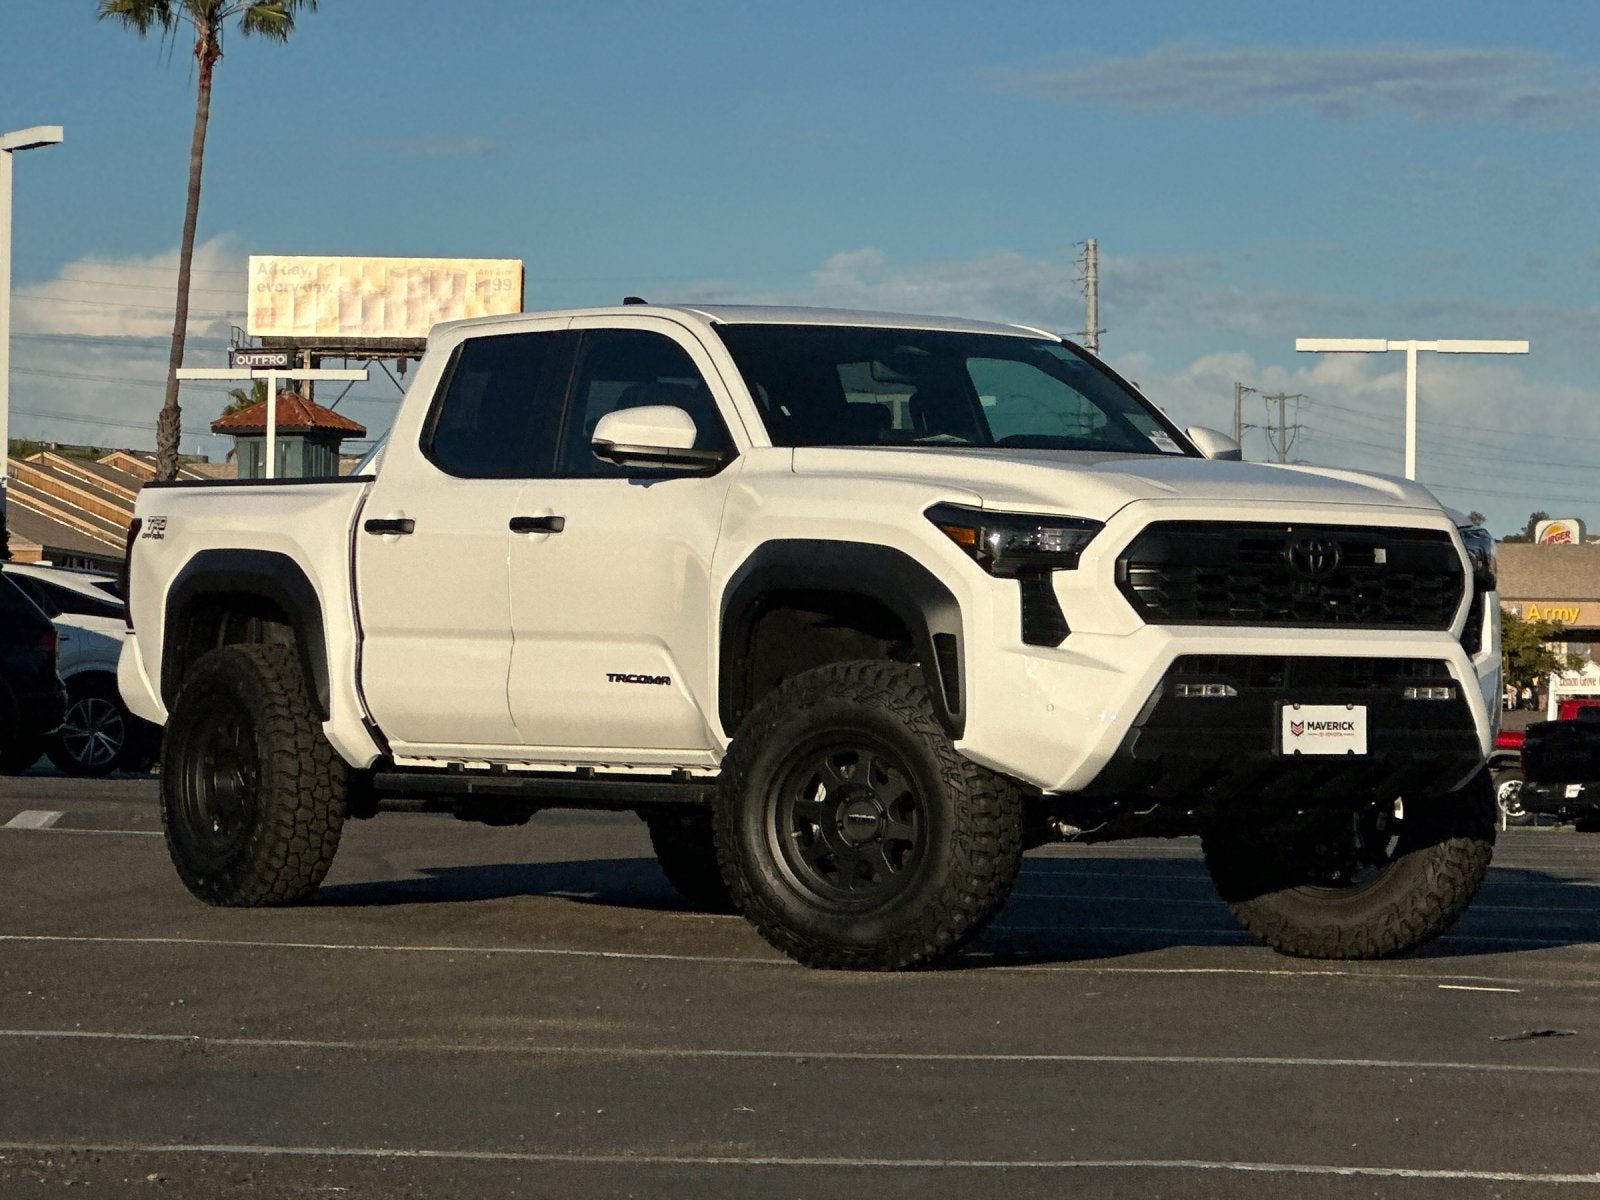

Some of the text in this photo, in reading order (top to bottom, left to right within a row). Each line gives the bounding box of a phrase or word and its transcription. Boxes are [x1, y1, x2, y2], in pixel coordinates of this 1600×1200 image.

[236, 355, 285, 365] OUTFRO
[1527, 603, 1580, 624] Army
[606, 673, 671, 686] TACOMA
[1307, 721, 1354, 731] MAVERICK
